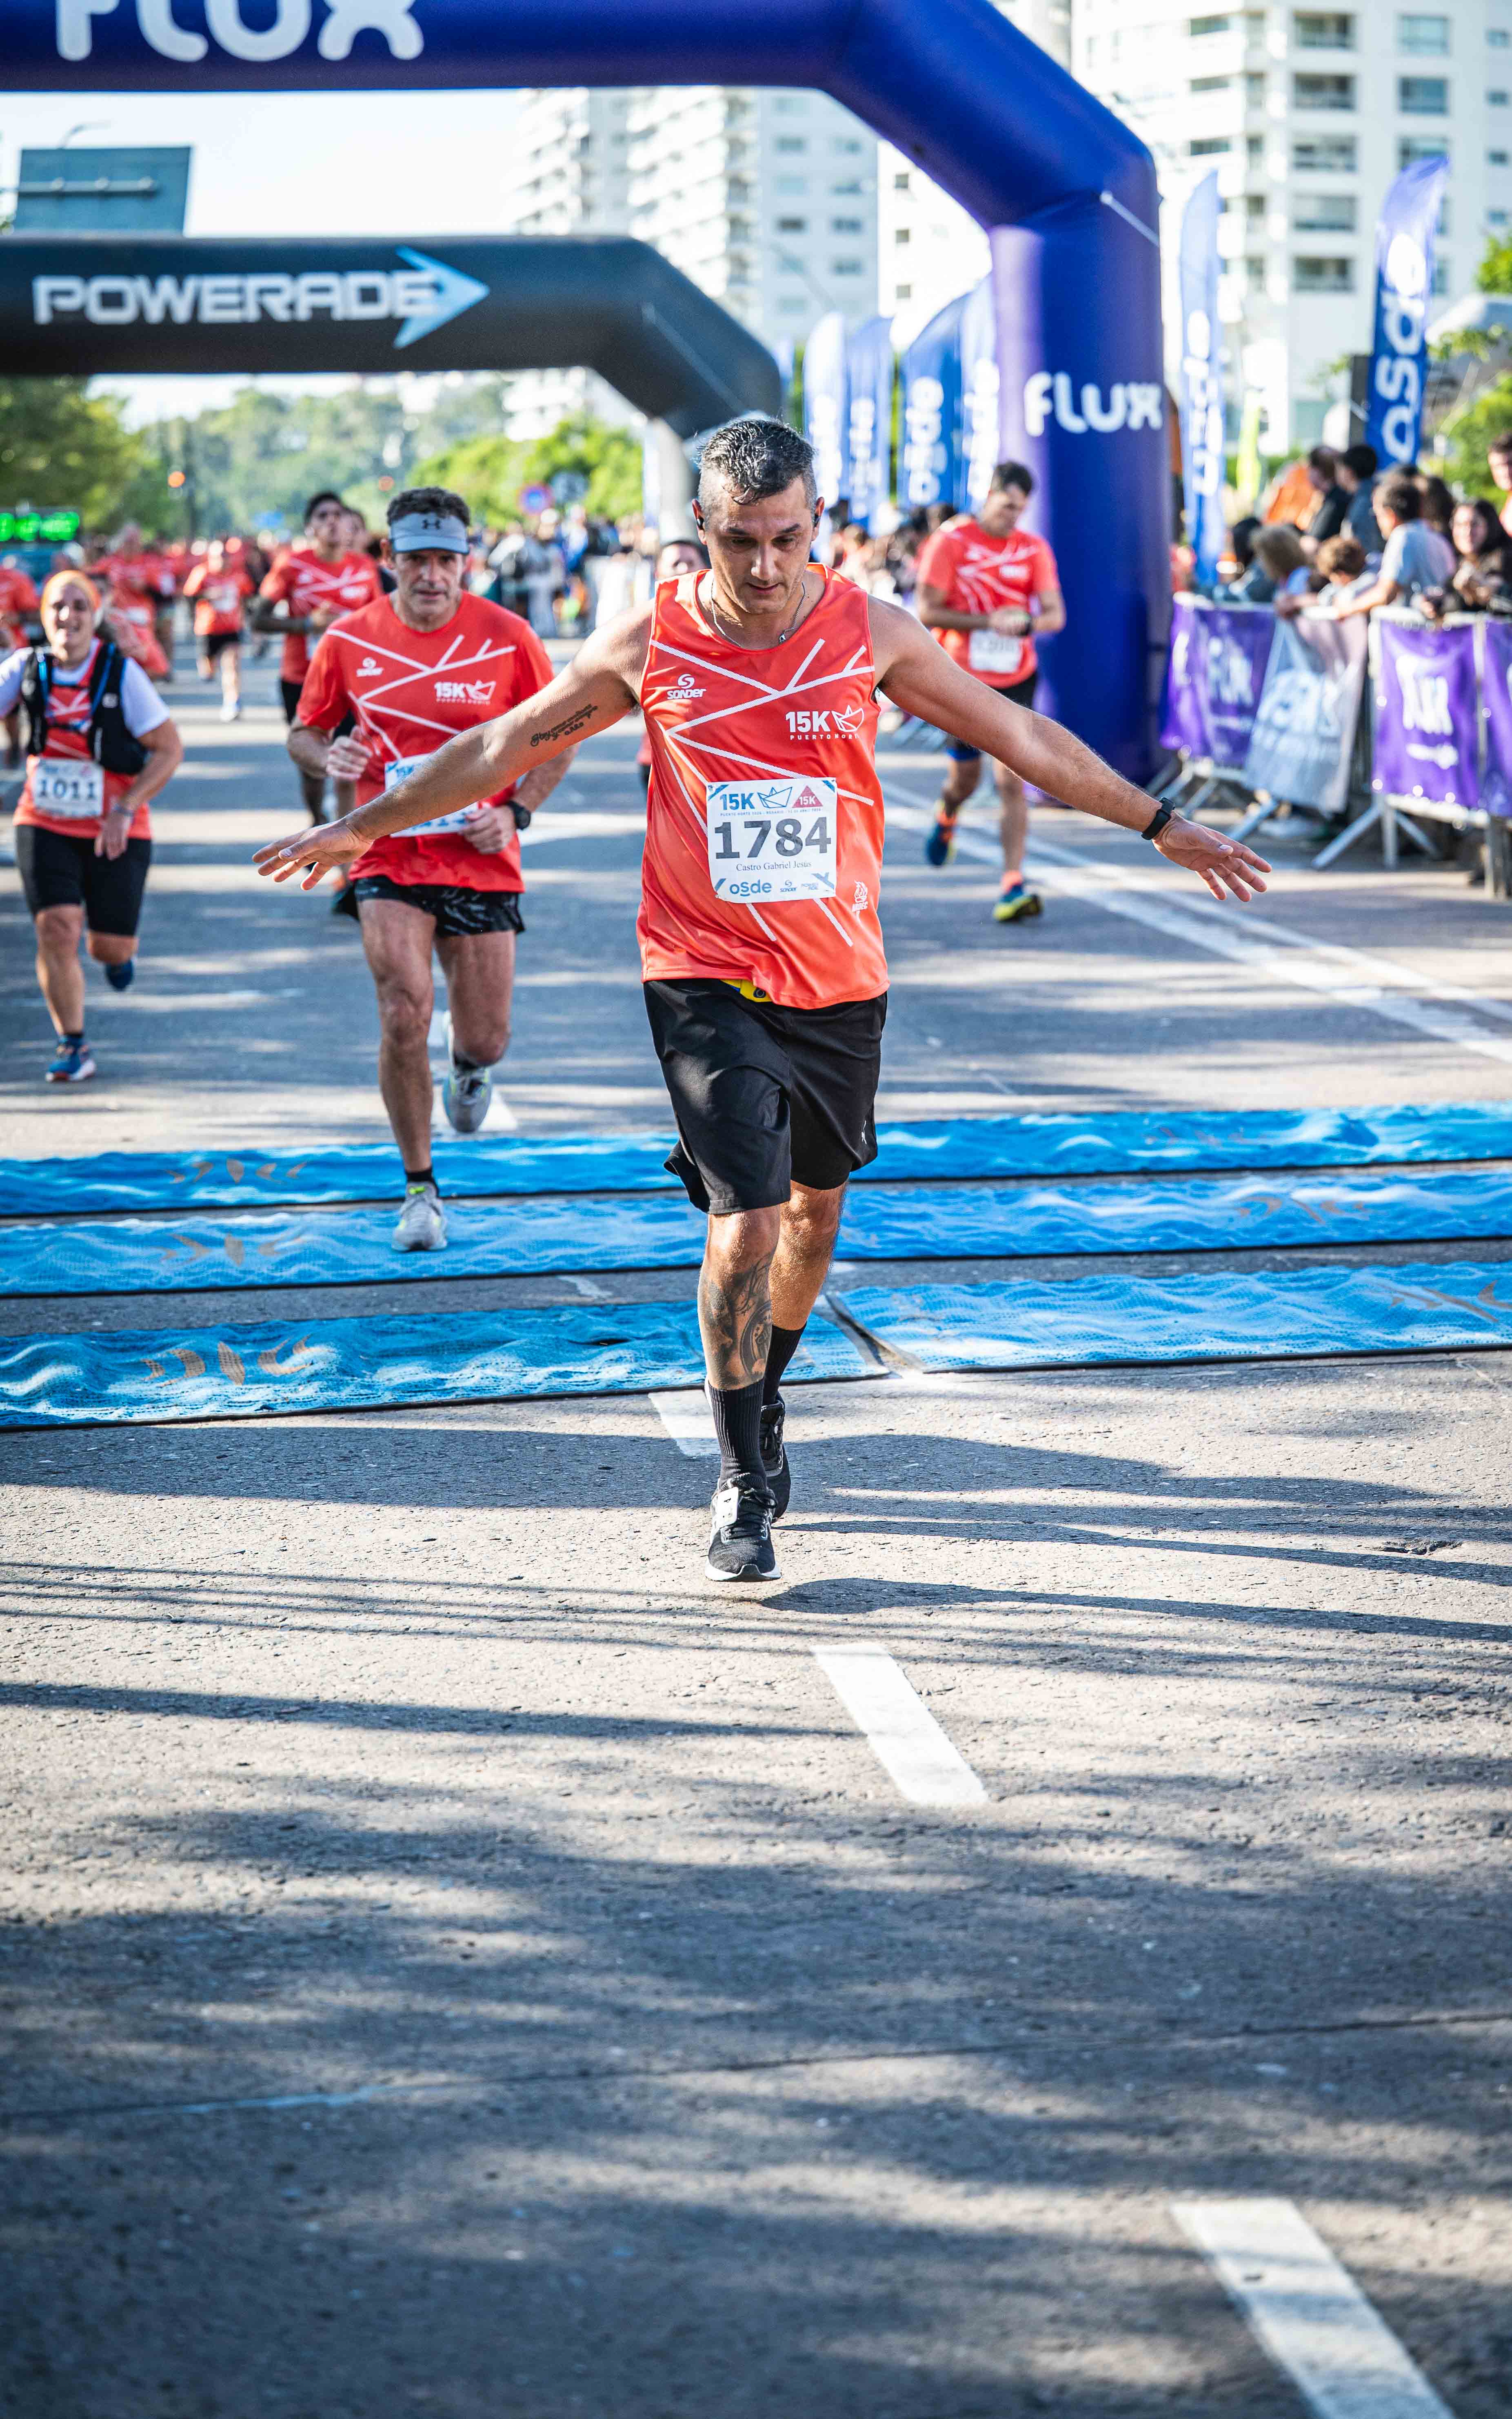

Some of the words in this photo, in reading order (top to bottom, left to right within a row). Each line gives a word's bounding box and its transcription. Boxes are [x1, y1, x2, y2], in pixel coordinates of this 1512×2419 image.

[32, 269, 440, 325] POWERADE
[1024, 371, 1163, 437] FLUX
[434, 682, 466, 699] 15K
[786, 711, 830, 733] 15K
[39, 777, 96, 800] 1011
[720, 793, 755, 810] 15K
[799, 795, 815, 805] 15K
[715, 817, 831, 859] 1784
[764, 861, 790, 869] Gabriel
[730, 879, 772, 895] osde
